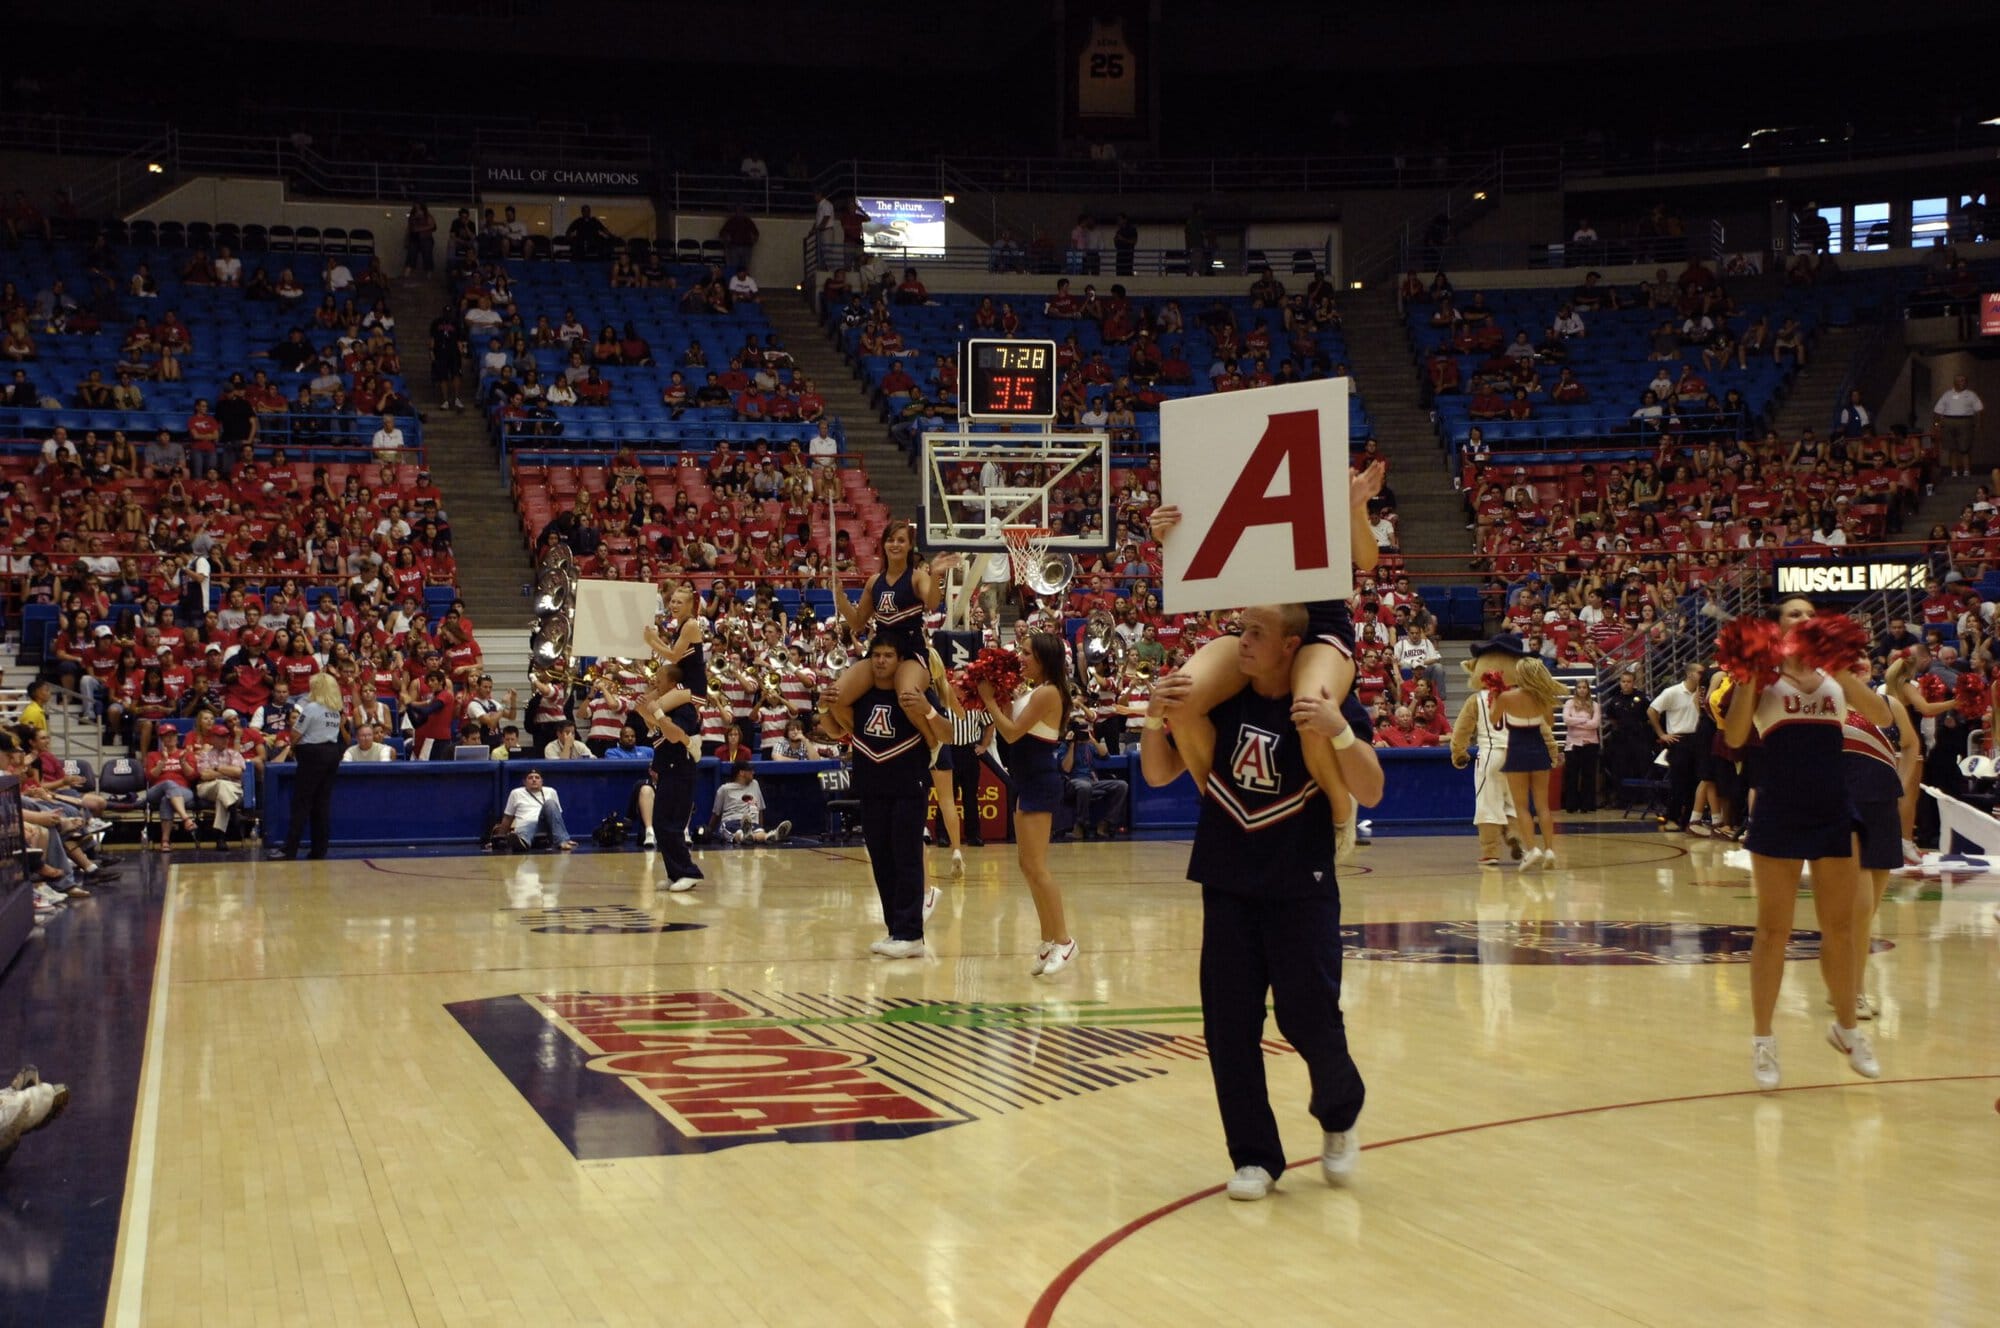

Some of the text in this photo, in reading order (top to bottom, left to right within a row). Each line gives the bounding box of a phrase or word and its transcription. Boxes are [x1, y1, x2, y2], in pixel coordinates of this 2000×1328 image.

[1090, 53, 1124, 79] 25
[487, 167, 640, 186] HALL OF CHAMPIONS
[875, 200, 925, 212] The Future.
[996, 347, 1046, 369] 7:28
[989, 375, 1035, 411] 35
[681, 457, 695, 468] 21
[1181, 408, 1330, 582] A
[1777, 565, 1868, 593] MUSCLE
[878, 590, 899, 614] A
[1783, 695, 1838, 717] U of A
[864, 704, 896, 739] A
[1230, 722, 1283, 796] A
[821, 770, 851, 790] FSN
[530, 989, 952, 1138] ARIZONA
